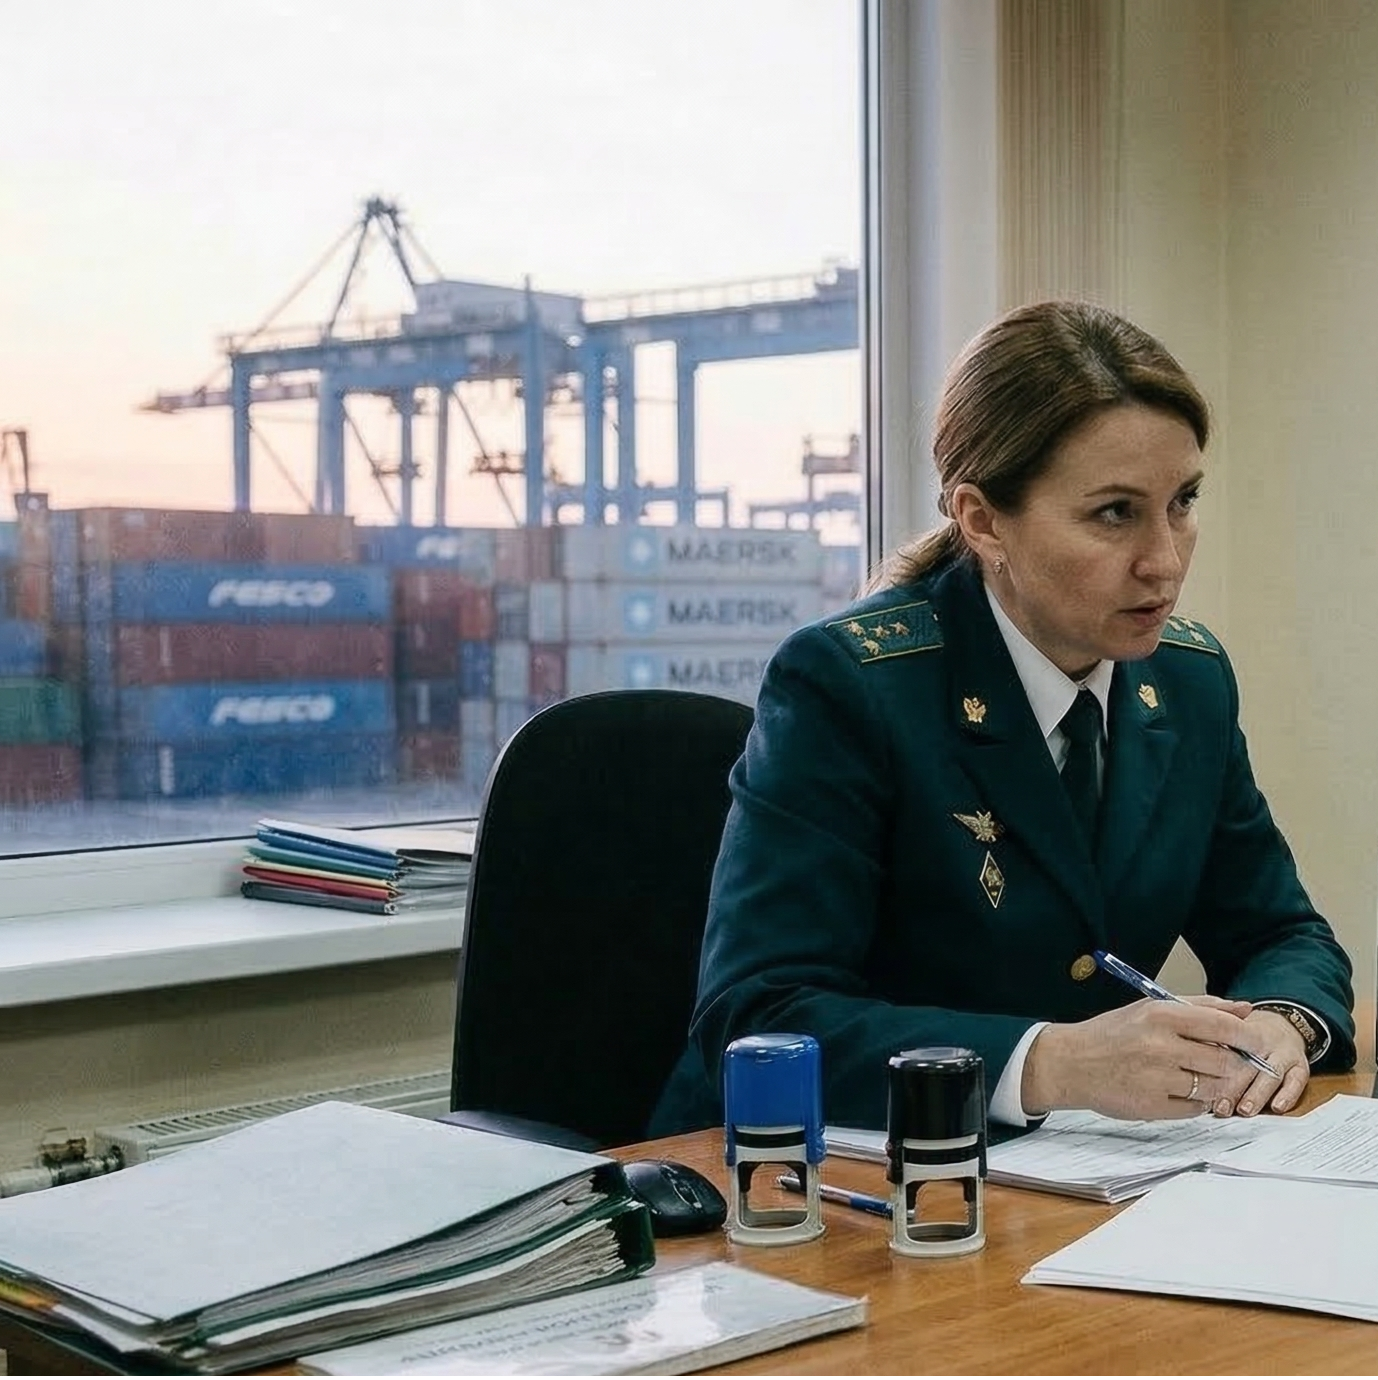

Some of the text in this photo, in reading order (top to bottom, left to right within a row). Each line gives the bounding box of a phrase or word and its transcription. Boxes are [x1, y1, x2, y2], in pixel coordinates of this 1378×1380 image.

[667, 538, 798, 565] MAERSK
[207, 579, 335, 608] FESCO
[667, 598, 798, 625] MAERSK
[667, 658, 766, 687] MAER
[208, 694, 336, 726] FESCO
